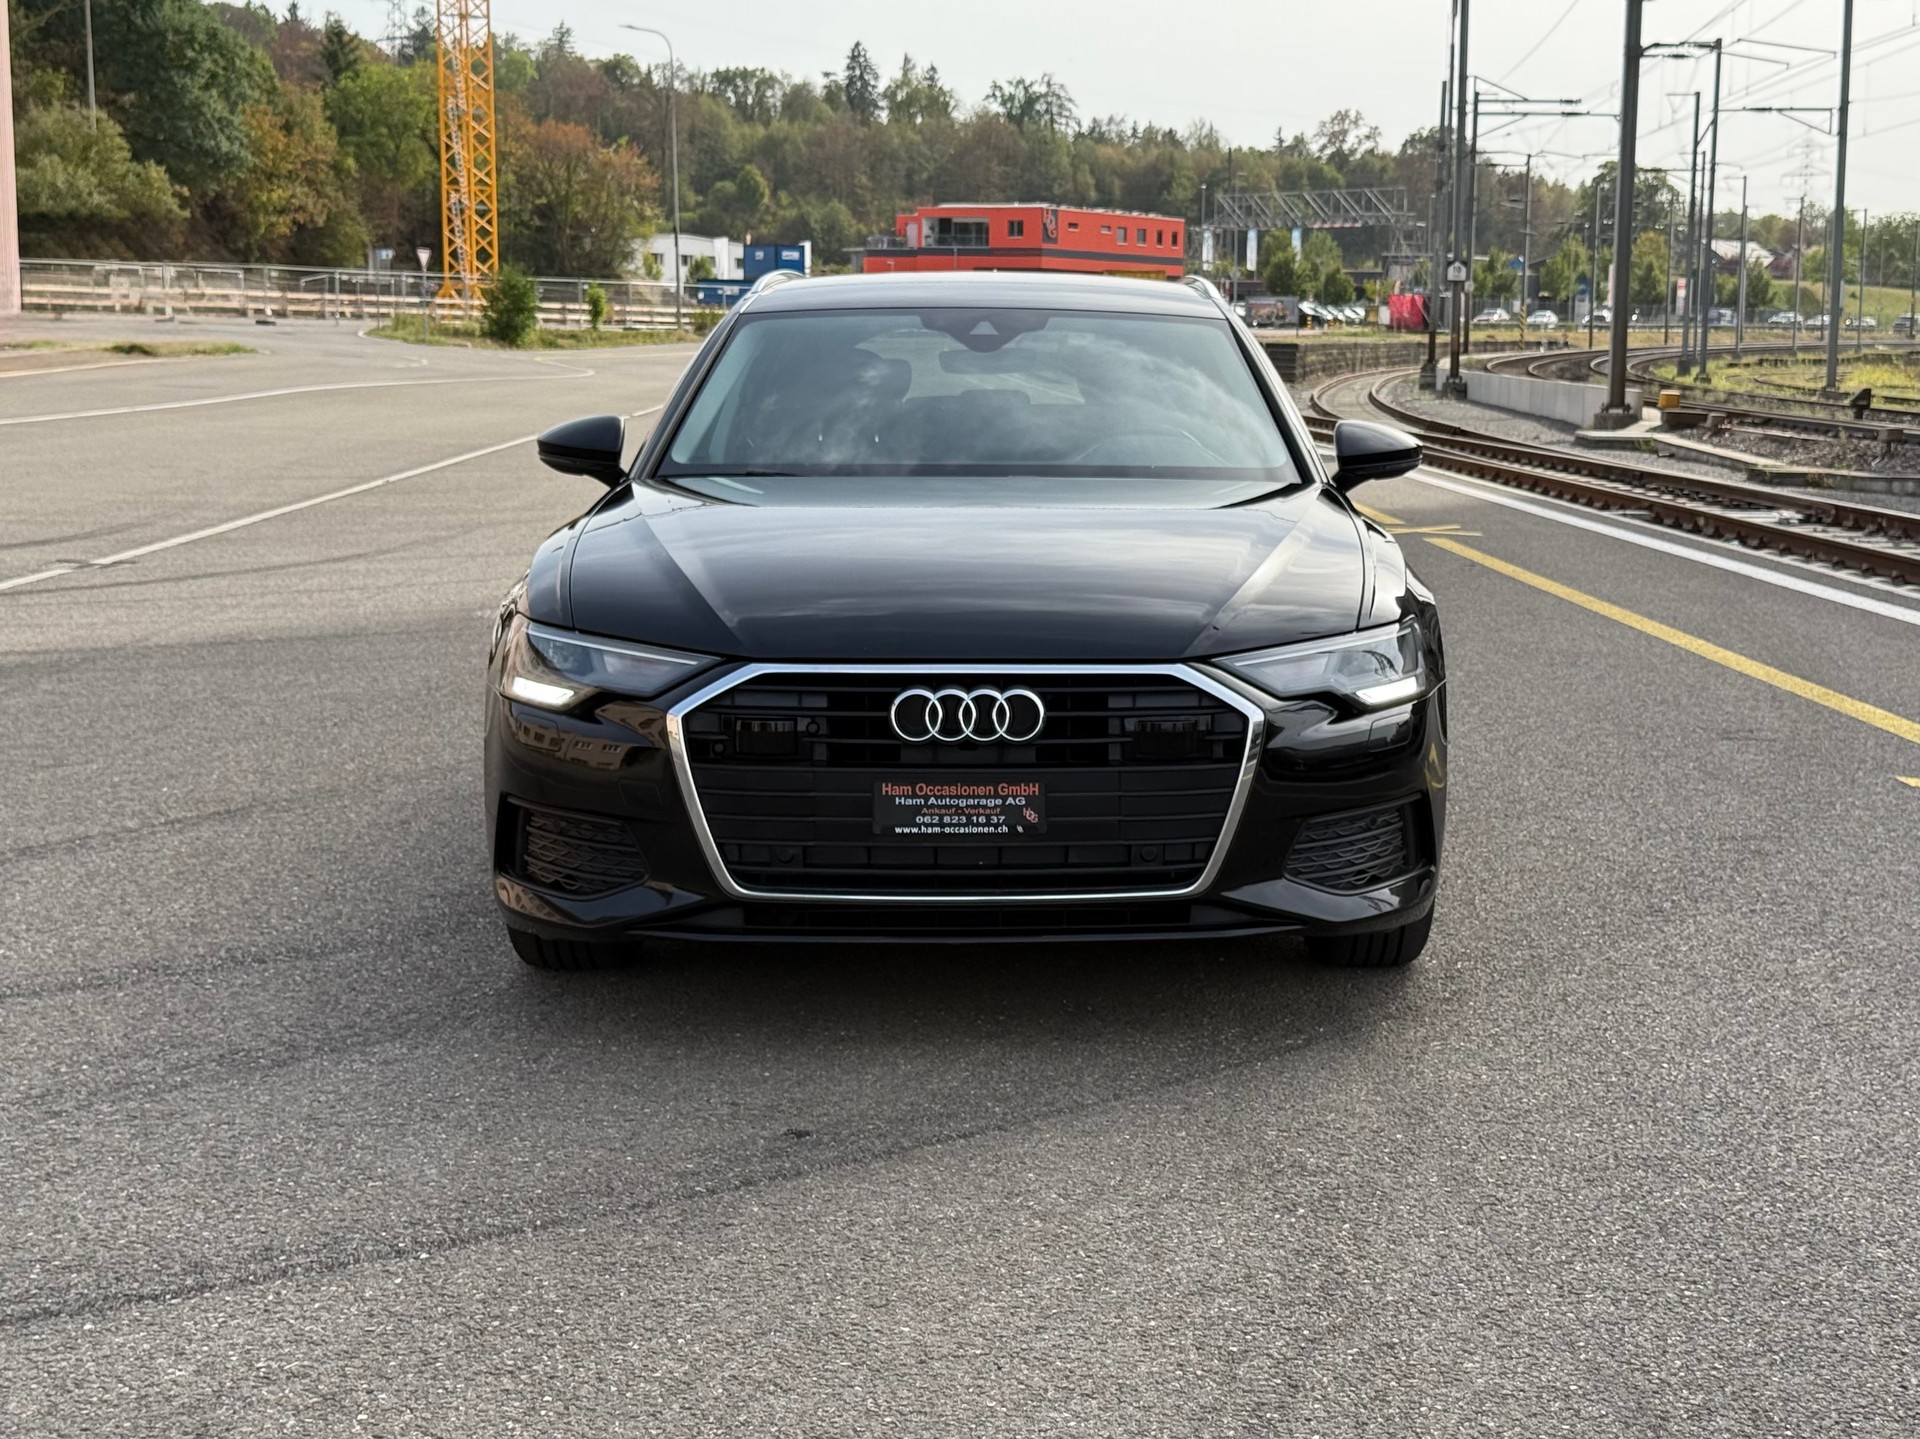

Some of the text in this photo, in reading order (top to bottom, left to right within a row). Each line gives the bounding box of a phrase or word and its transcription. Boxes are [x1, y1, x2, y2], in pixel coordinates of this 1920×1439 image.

[882, 783, 1039, 796] Ham Occasionen GmbH
[895, 797, 1026, 807] Ham Autogarage AG
[921, 807, 956, 815] Ankauf
[963, 807, 1001, 815] Verkauf
[916, 816, 1006, 824] 062 823 16 37
[894, 825, 1009, 834] www.ham-occasionen.ch
